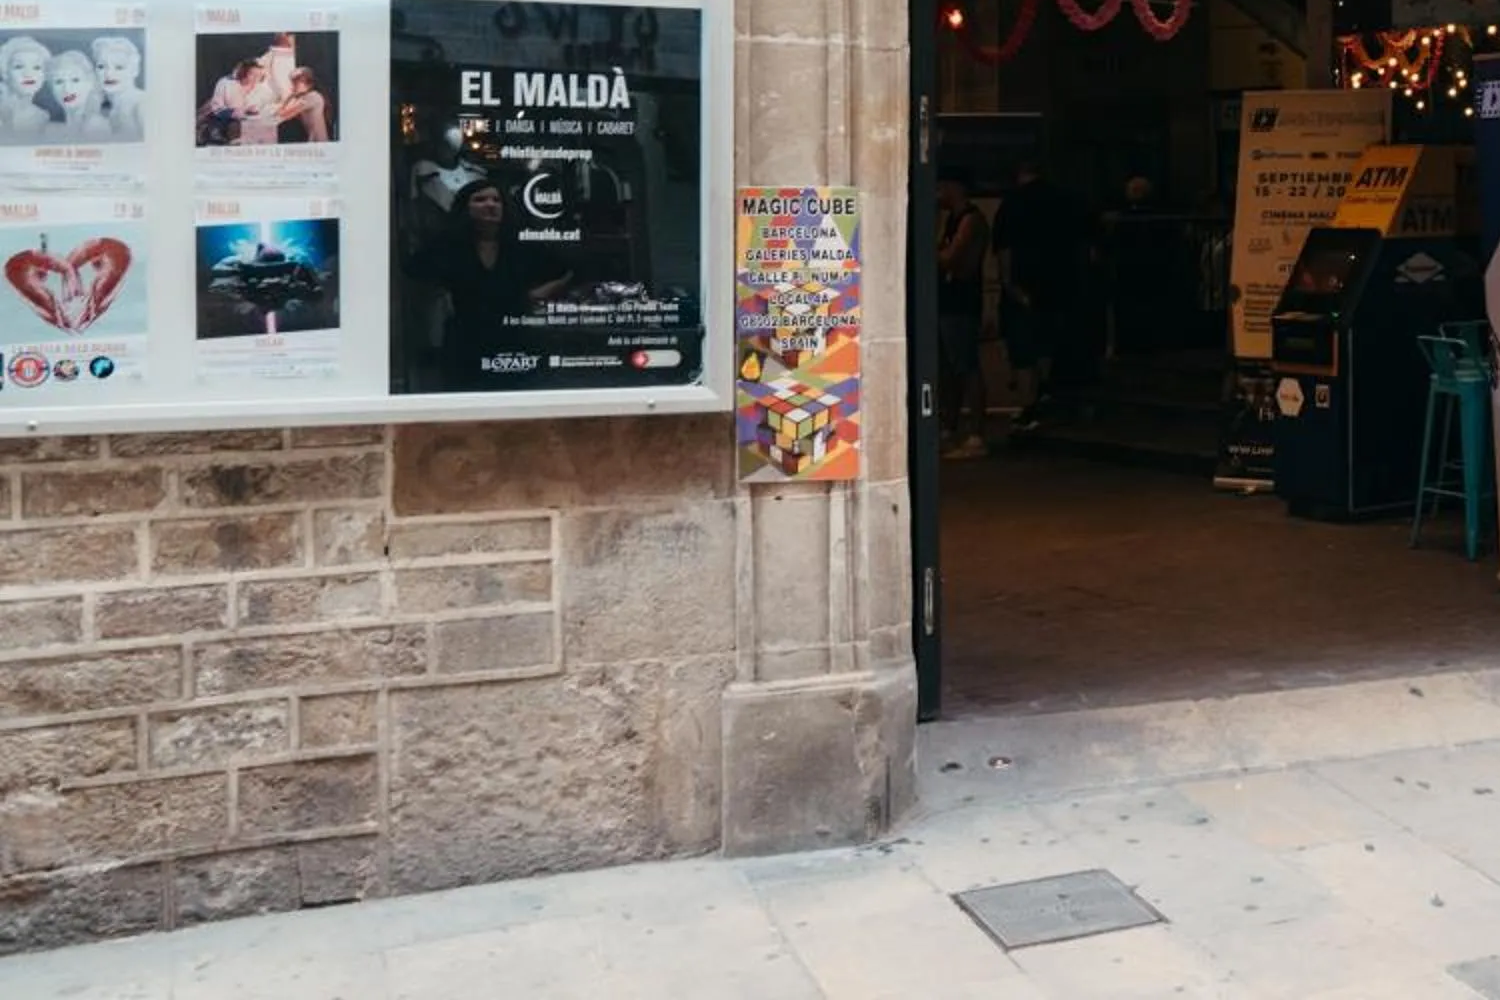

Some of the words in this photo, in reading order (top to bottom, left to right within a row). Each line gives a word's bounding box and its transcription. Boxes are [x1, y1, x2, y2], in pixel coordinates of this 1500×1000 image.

[461, 71, 500, 106] EL
[514, 66, 631, 109] MALDÀ
[1258, 171, 1352, 184] SEPTIEMBR
[1355, 166, 1409, 188] ATM
[1288, 185, 1306, 197] 22
[743, 198, 800, 215] MAGIC
[807, 198, 855, 215] CUBE
[762, 227, 837, 239] BARCELONA
[746, 250, 806, 261] GALERIES
[812, 249, 853, 261] MALDA
[749, 271, 788, 283] CALLE
[784, 315, 857, 327] BARCELONA
[781, 338, 819, 348] SPAIN
